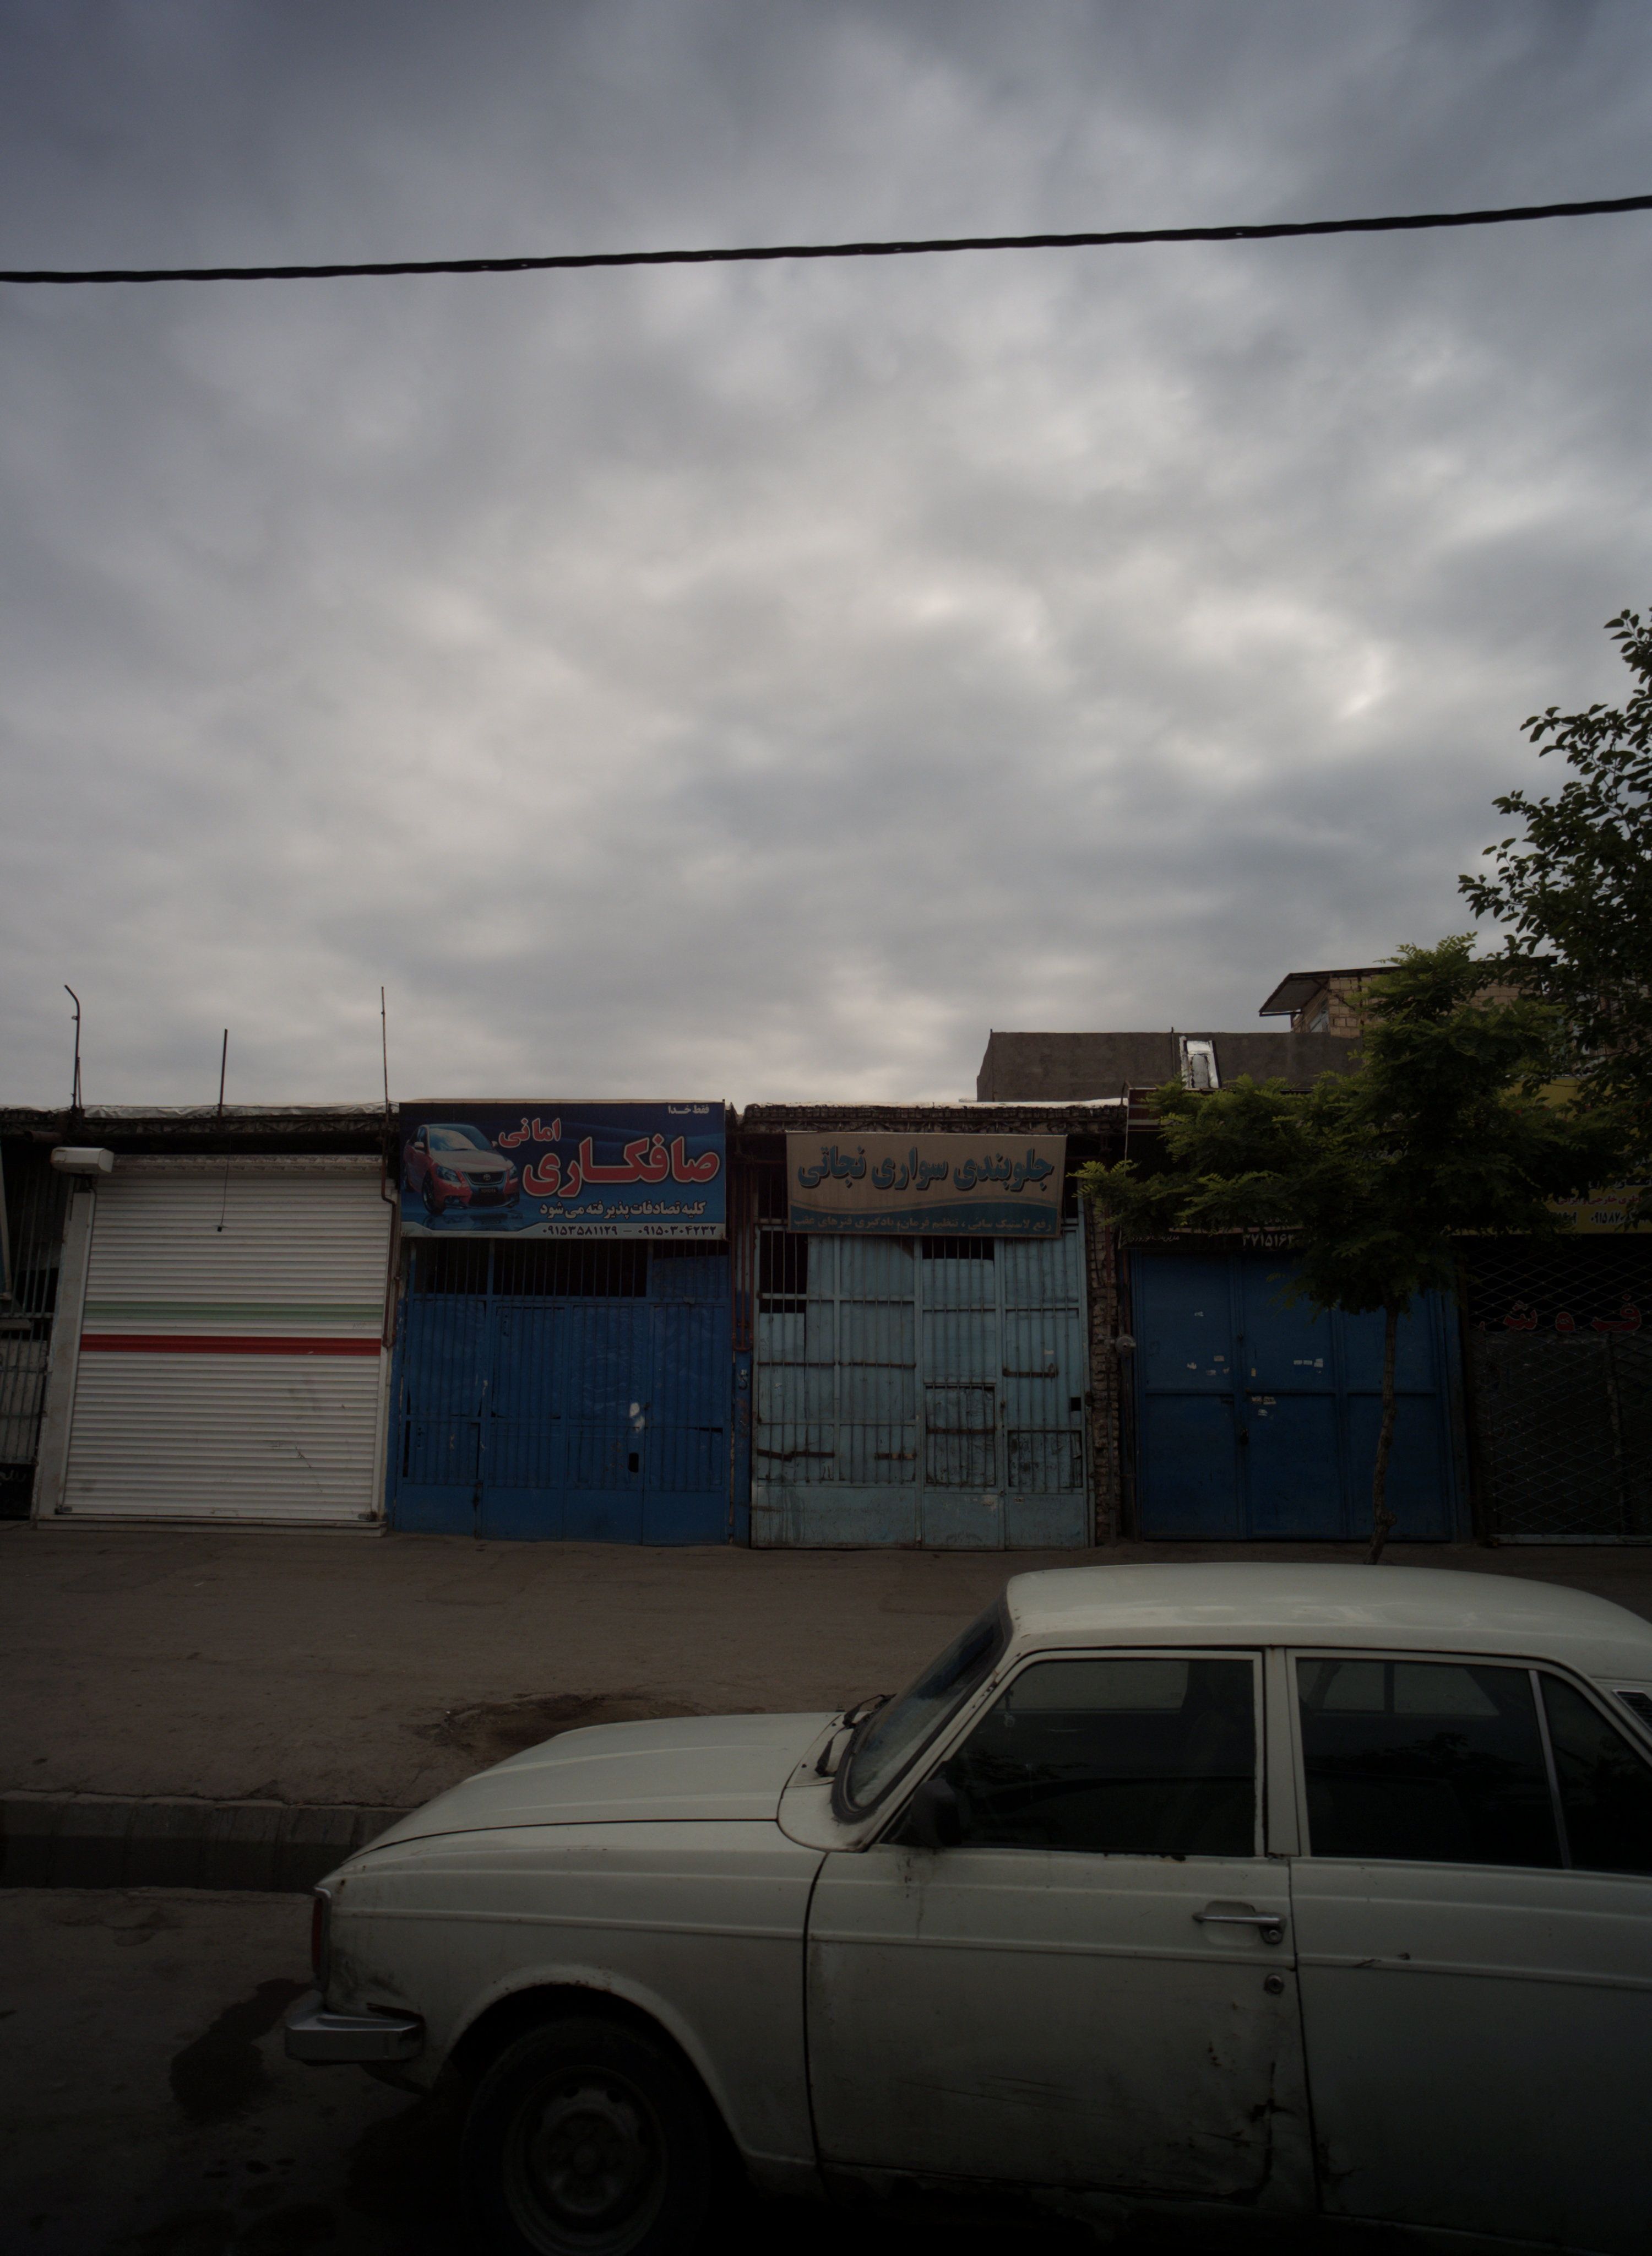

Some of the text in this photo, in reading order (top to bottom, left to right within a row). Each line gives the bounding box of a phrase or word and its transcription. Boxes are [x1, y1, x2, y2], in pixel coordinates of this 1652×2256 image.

[667, 1104, 710, 1115] فقط خدا
[498, 1118, 562, 1148] امانی
[522, 1134, 720, 1198] صافکاری
[797, 1145, 1055, 1191] جلوبندی سواری نجاتی
[631, 1201, 681, 1215] تصادفات
[682, 1201, 707, 1217] کلیه
[932, 1217, 959, 1229] تنظیم
[995, 1218, 1030, 1230] لاستیک
[1033, 1219, 1052, 1232] رفع
[542, 1224, 618, 1236] ۰۹۱۵۳۵۸۱۱۲۹
[638, 1225, 717, 1236] ۰۹۱۵۰۳۰۴۲۳۲
